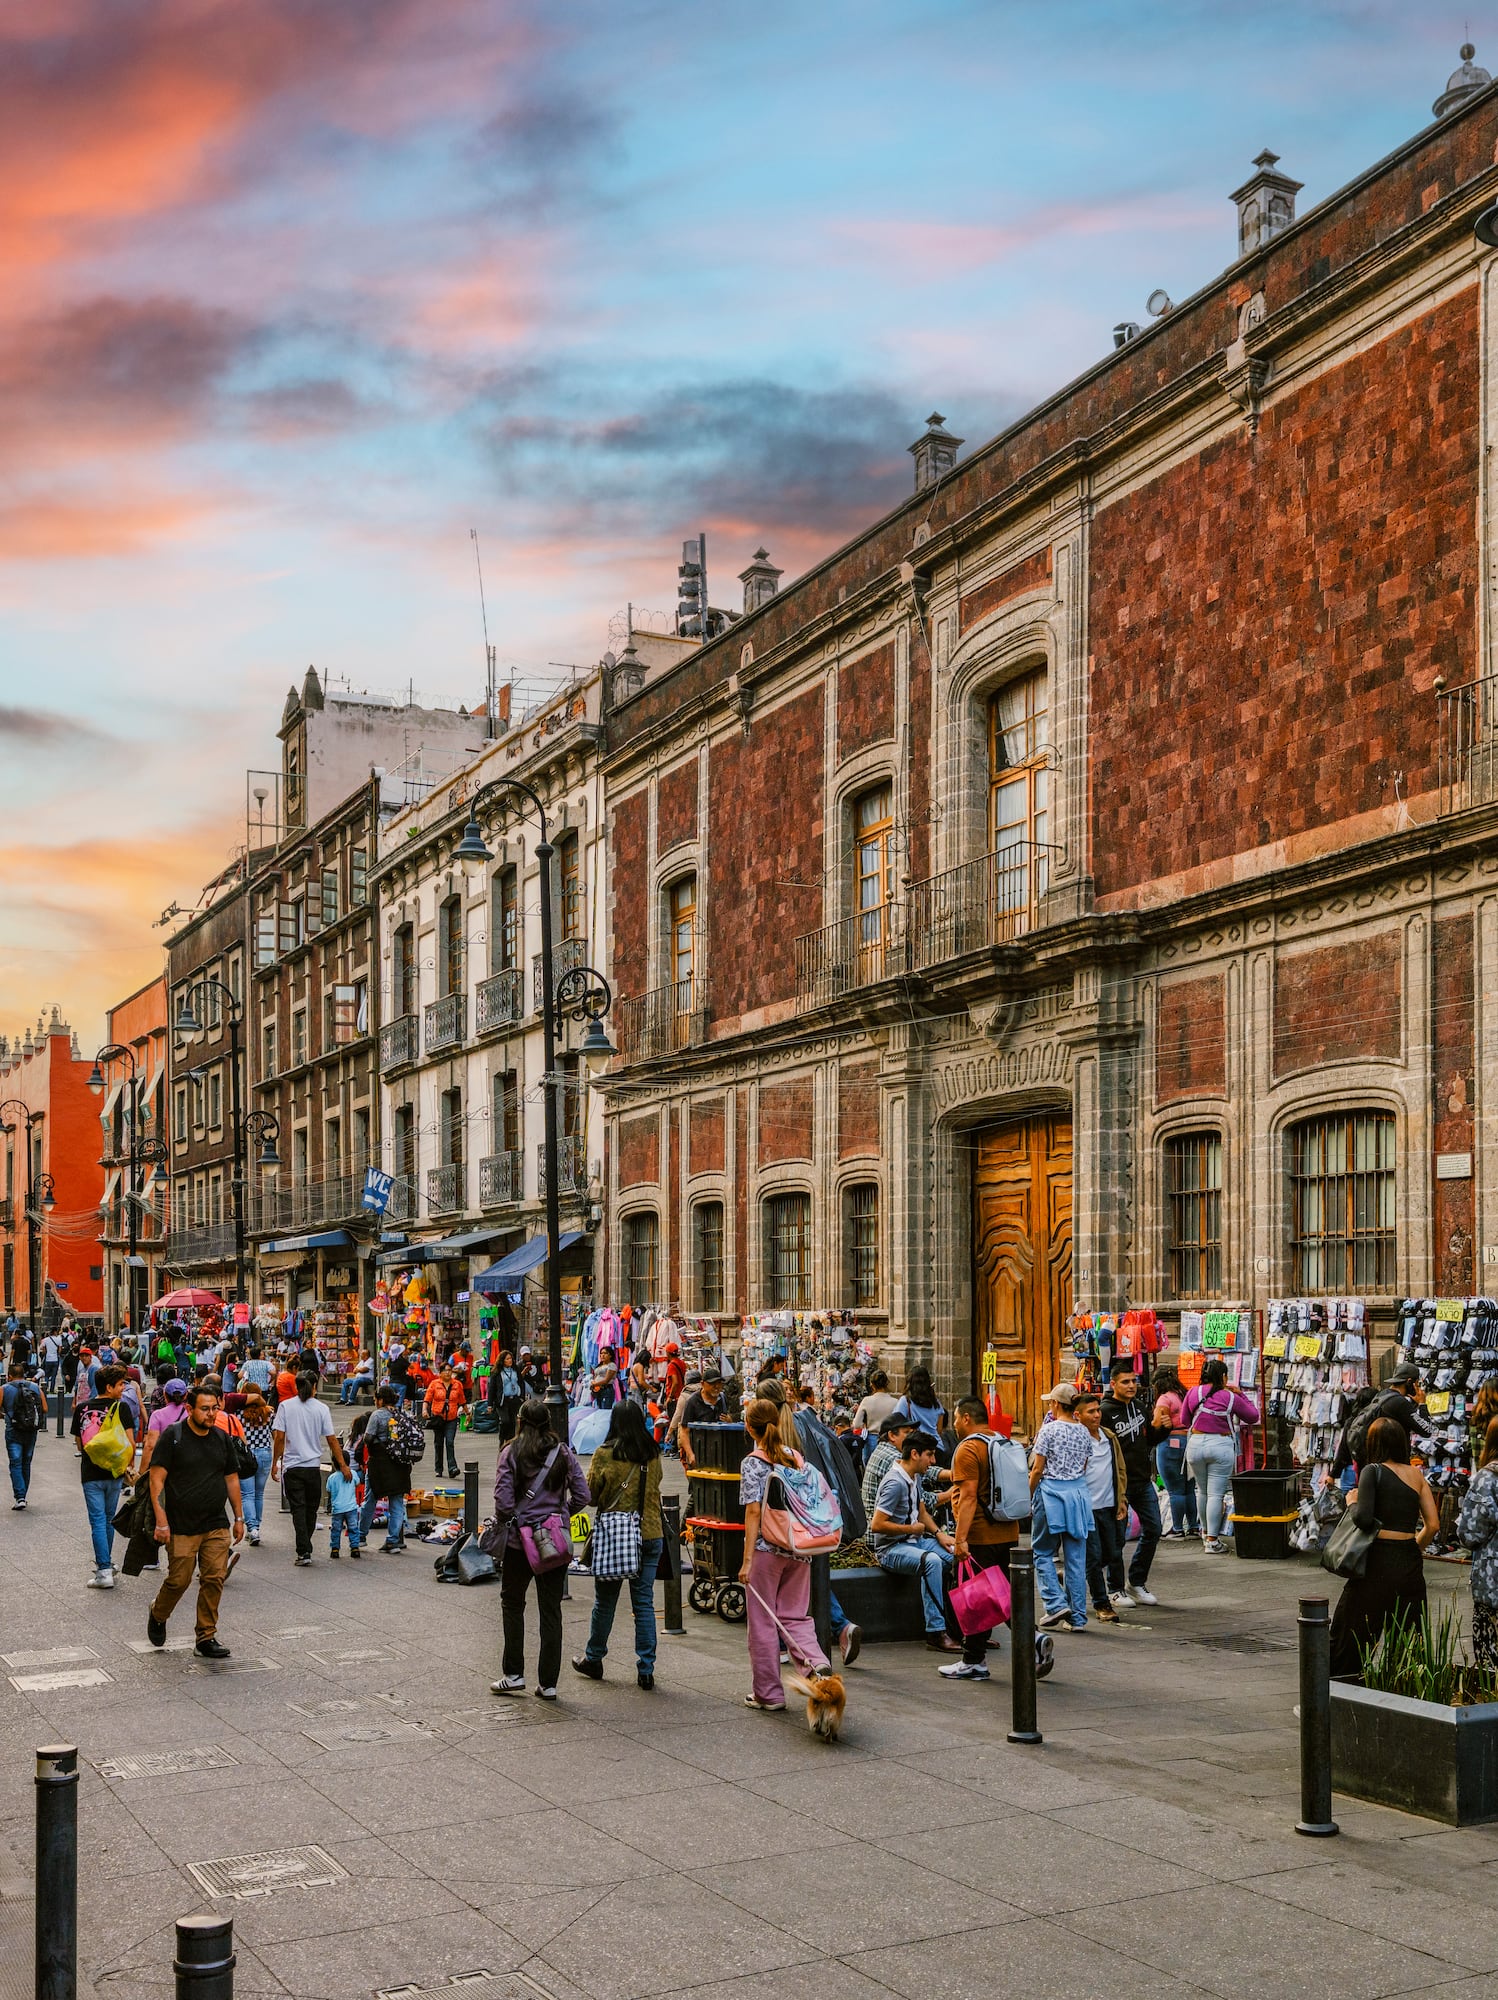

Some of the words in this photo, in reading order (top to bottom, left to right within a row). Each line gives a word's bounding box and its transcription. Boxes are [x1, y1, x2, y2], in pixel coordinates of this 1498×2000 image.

[1487, 1247, 1496, 1262] B
[1256, 1259, 1264, 1273] C
[983, 1363, 995, 1382] 10
[574, 1514, 589, 1538] 10
